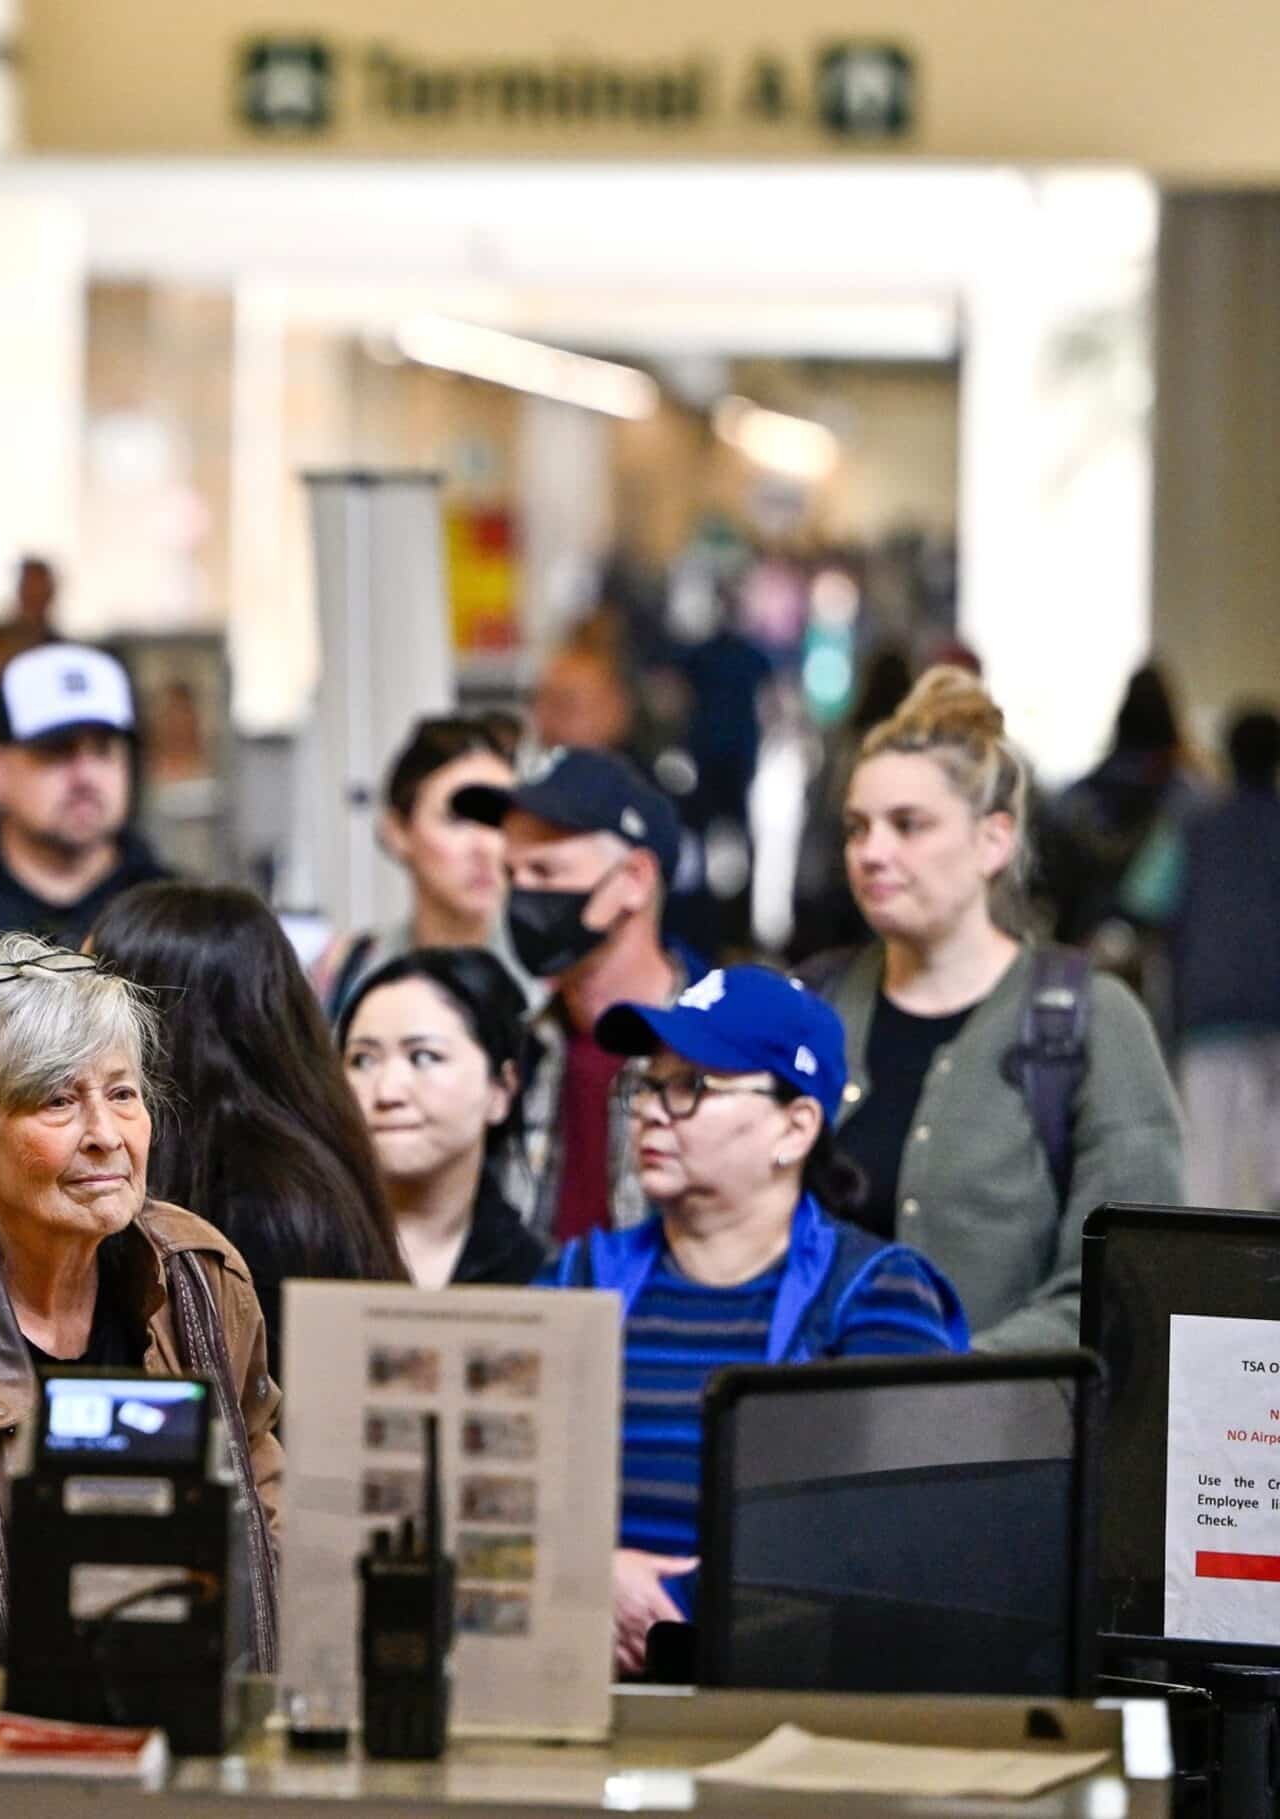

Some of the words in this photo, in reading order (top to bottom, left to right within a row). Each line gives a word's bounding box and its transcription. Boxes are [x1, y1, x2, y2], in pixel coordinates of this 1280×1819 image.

[1242, 1360, 1266, 1373] TSA
[1227, 1430, 1248, 1441] NO
[1198, 1474, 1222, 1486] Use
[1234, 1476, 1255, 1489] the
[1197, 1493, 1259, 1510] Employee
[1197, 1513, 1238, 1528] Check.
